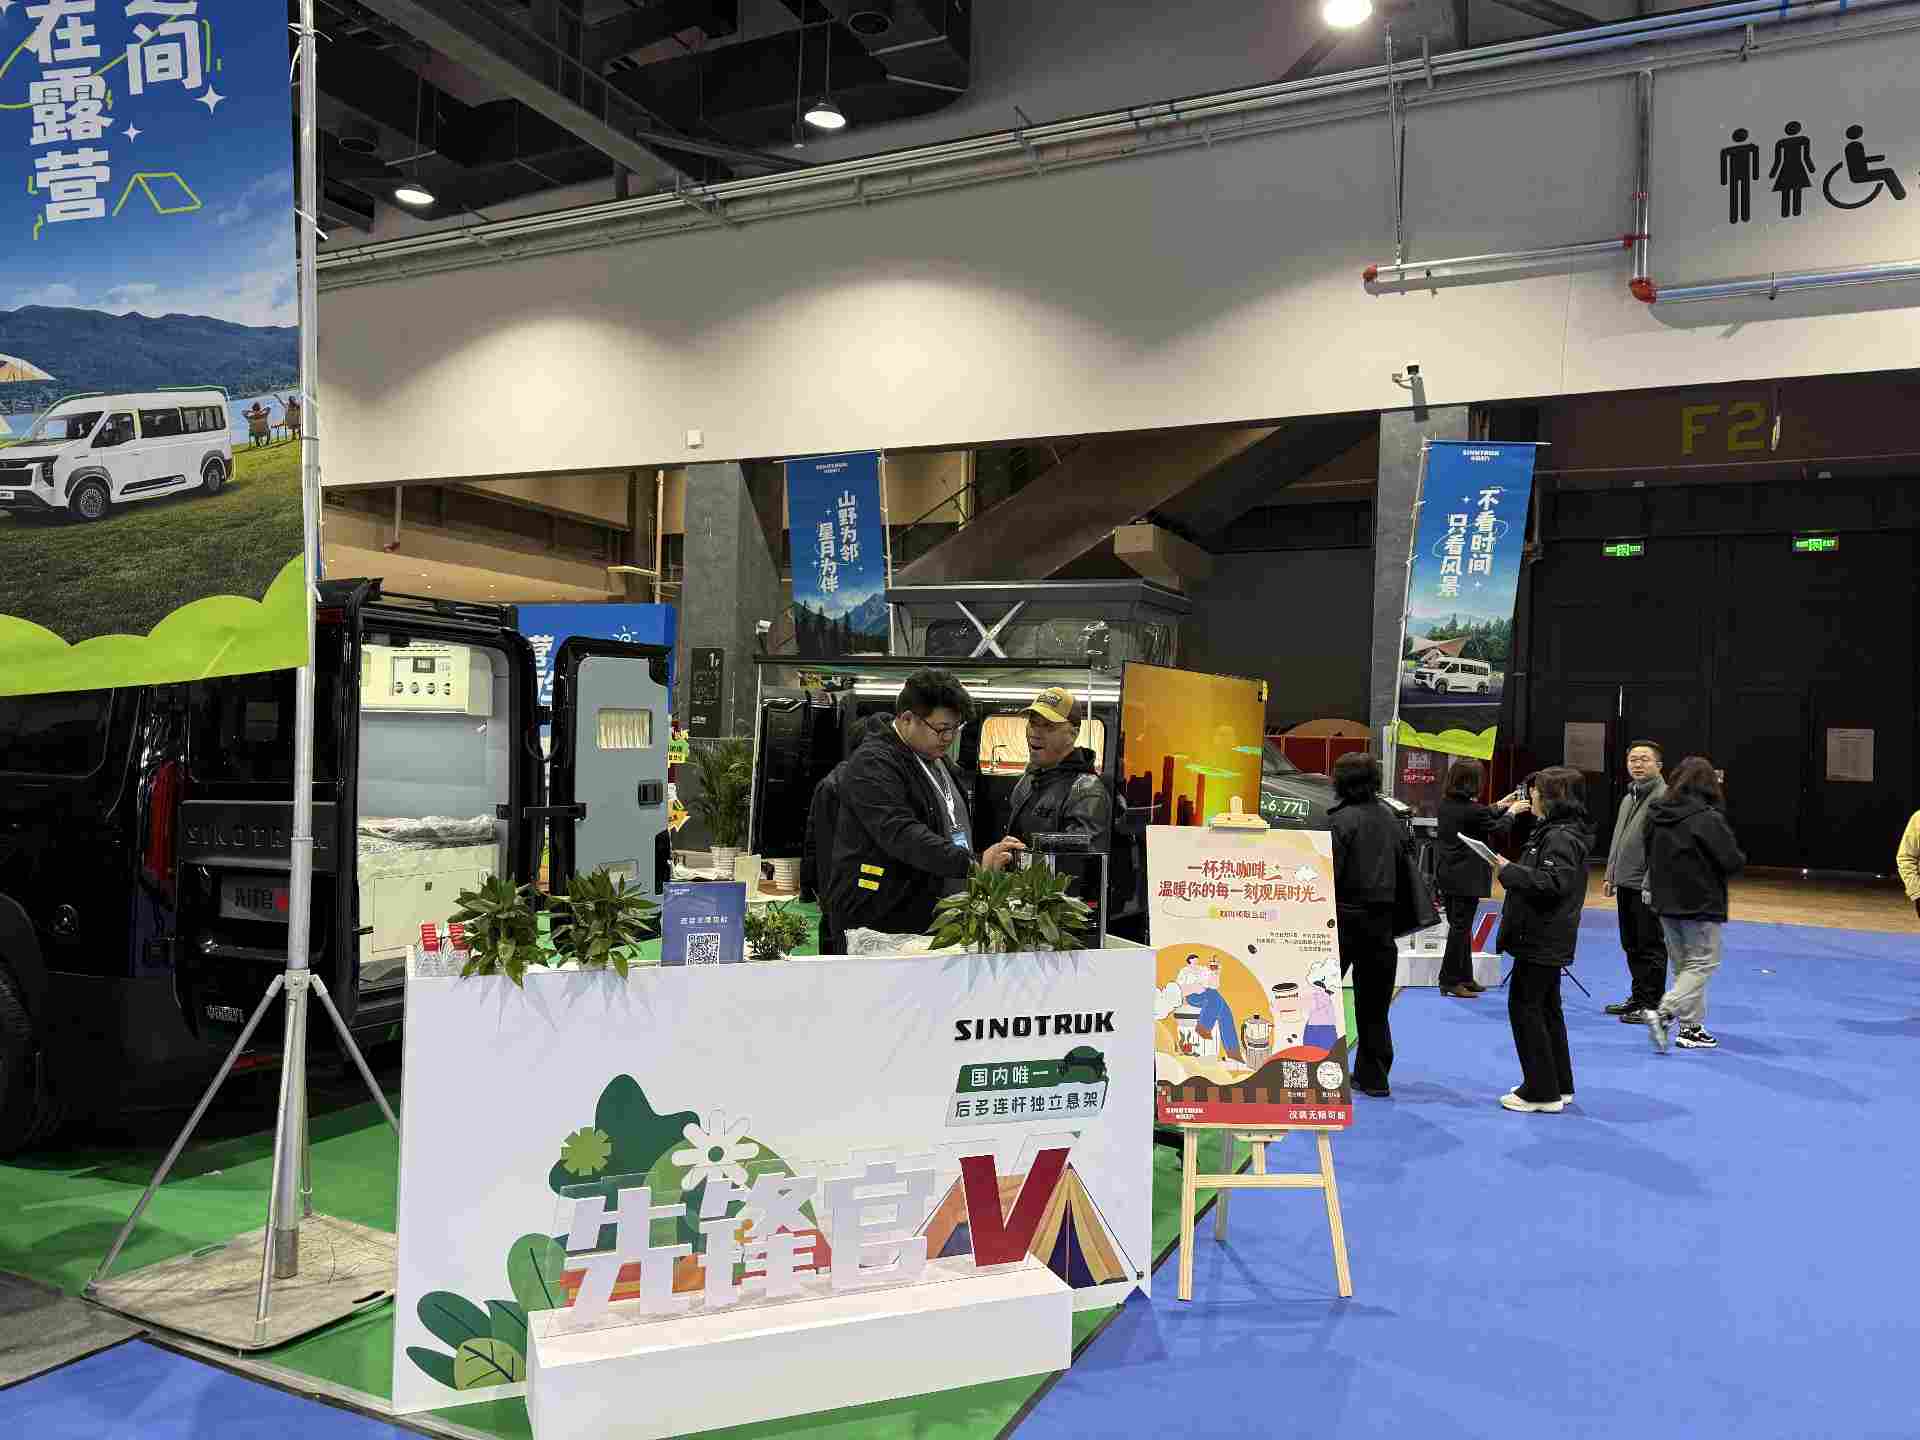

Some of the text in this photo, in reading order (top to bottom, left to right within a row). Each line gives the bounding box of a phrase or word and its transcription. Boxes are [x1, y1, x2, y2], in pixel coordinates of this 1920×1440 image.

[26, 0, 112, 222] 在露营
[1681, 401, 1766, 455] F2
[817, 521, 839, 592] 星月为伴
[837, 490, 859, 561] 山野为邻
[1438, 513, 1469, 598] 只看风景
[1468, 489, 1501, 576] 不看时间
[1188, 860, 1281, 880] 一杯热咖啡
[954, 1011, 1115, 1041] SINOTRUK
[955, 1091, 1099, 1118] 后多连杆独立悬架
[970, 1065, 1049, 1087] 国内唯一
